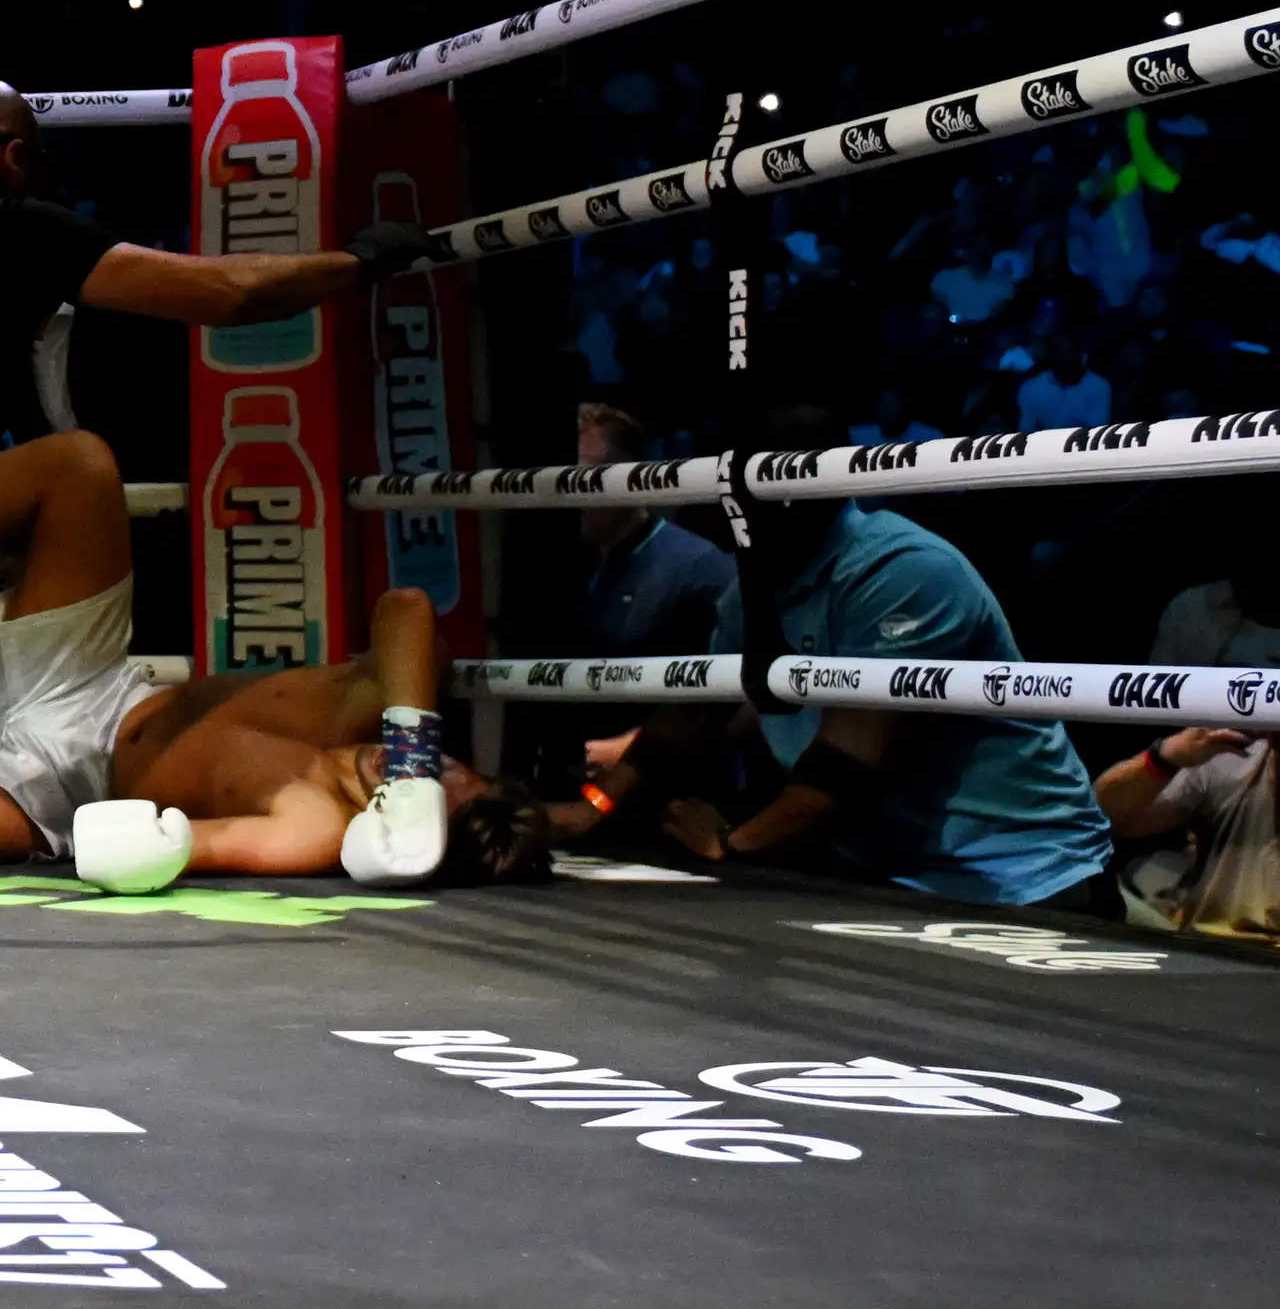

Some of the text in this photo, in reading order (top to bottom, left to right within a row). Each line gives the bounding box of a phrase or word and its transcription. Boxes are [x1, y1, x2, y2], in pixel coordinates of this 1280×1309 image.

[62, 94, 128, 107] BOXING
[709, 92, 742, 190] KICK
[767, 54, 1194, 181] Stake Stake Stake Stake Stake
[228, 139, 298, 253] PRI
[729, 268, 747, 370] KICK
[231, 486, 306, 662] PRIME
[663, 659, 714, 688] DAZN
[813, 667, 861, 690] BOXING
[889, 666, 953, 700] DAZN
[1012, 674, 1072, 699] BOXING
[1108, 673, 1192, 709] DAZN
[330, 1030, 862, 1163] BOXING
